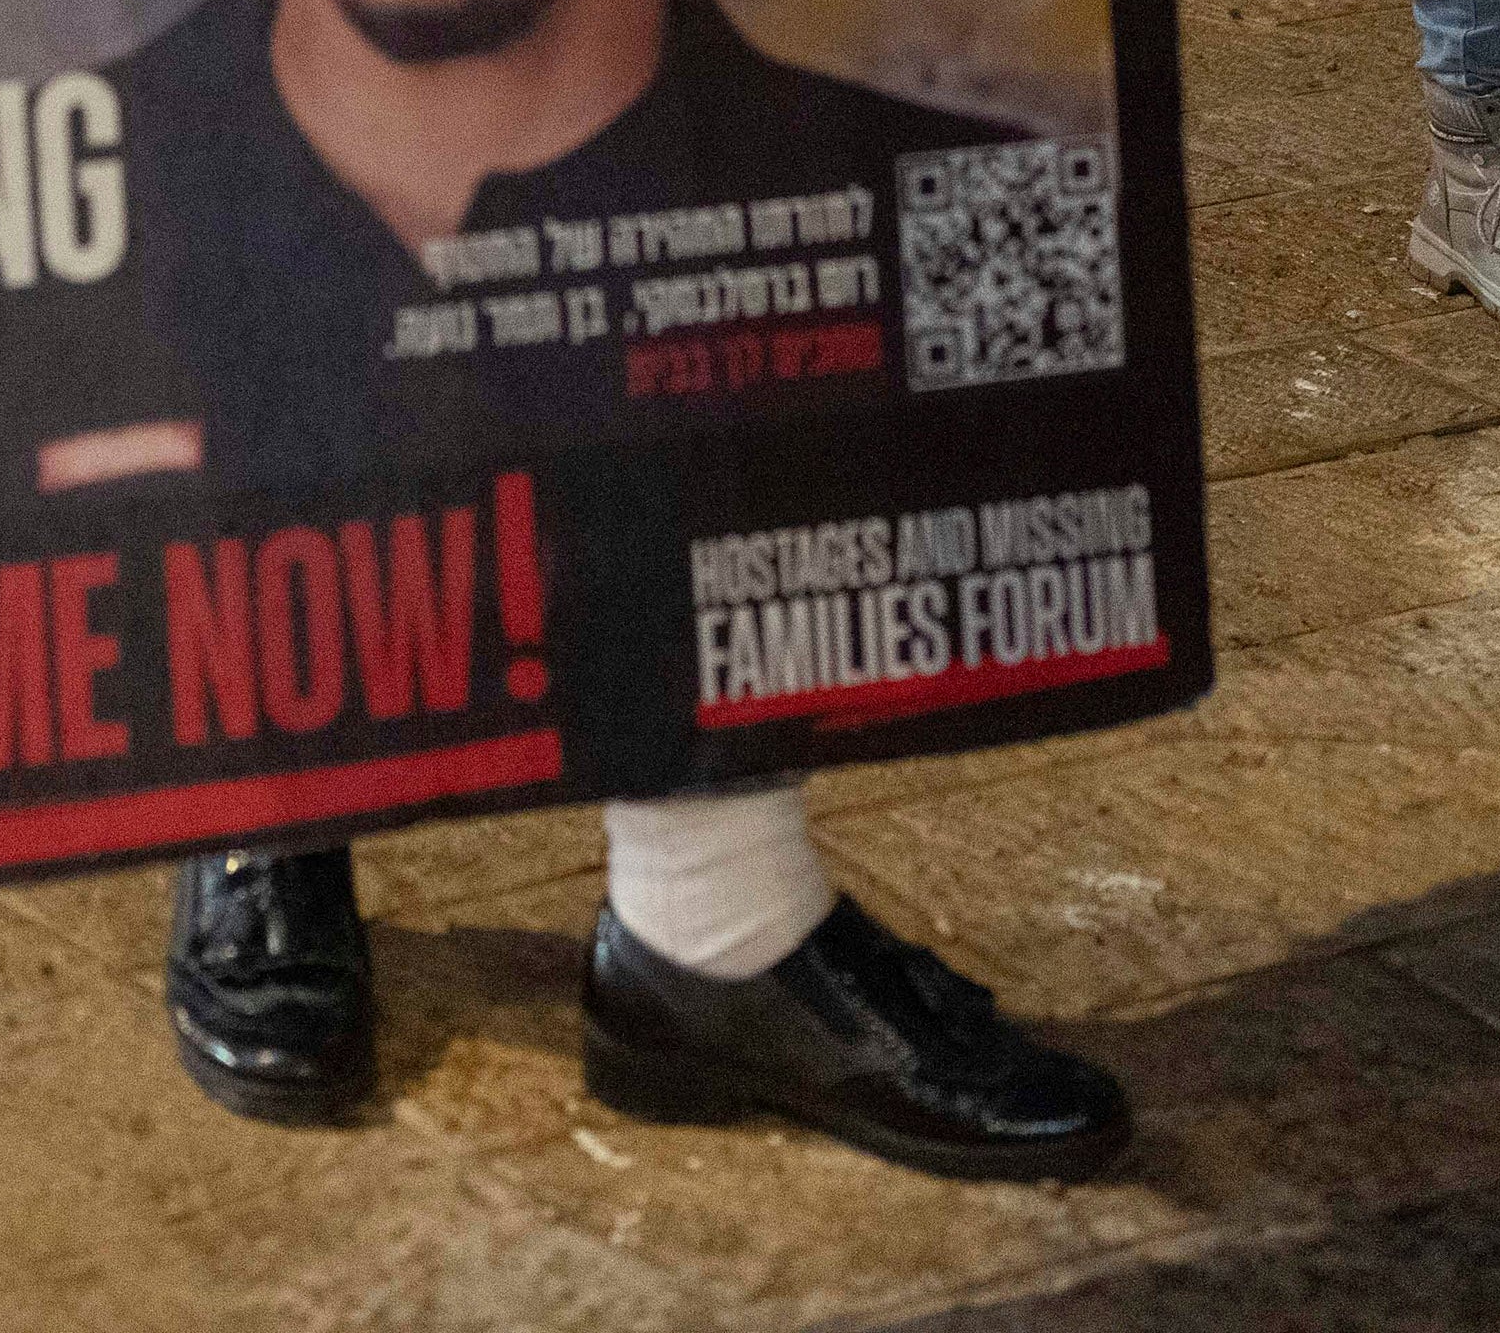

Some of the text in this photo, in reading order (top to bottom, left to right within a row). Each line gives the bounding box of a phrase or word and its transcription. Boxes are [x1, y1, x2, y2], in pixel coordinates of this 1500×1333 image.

[164, 473, 549, 747] NOW!
[692, 484, 1153, 606] HOSTAGES AND MISSING
[700, 553, 1158, 705] FAMILIES FORUM
